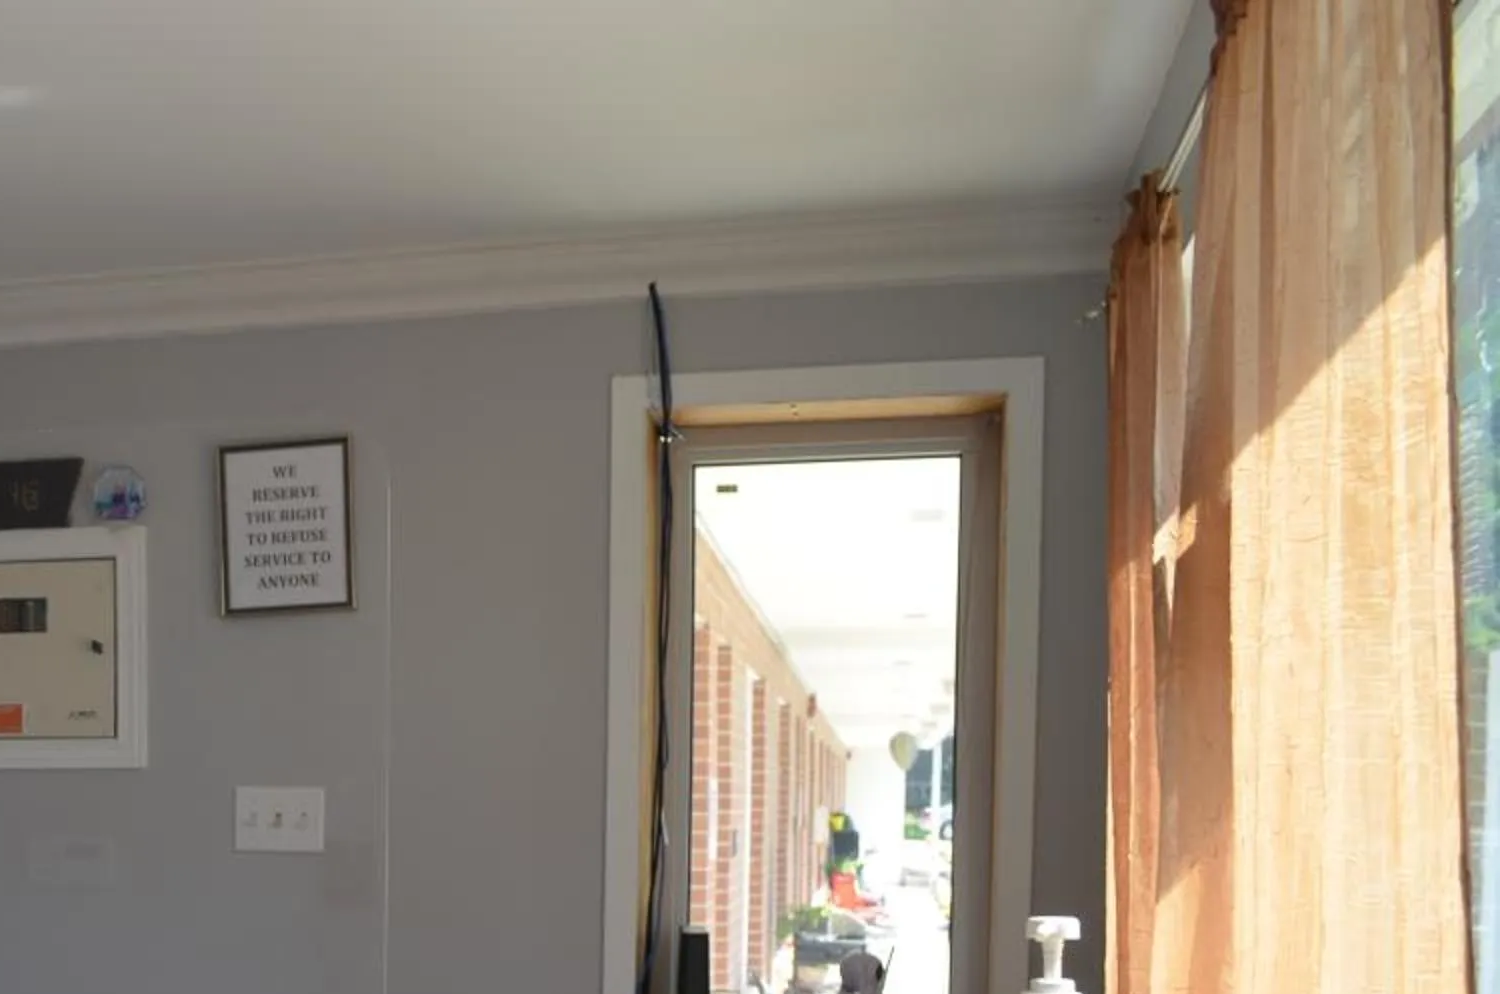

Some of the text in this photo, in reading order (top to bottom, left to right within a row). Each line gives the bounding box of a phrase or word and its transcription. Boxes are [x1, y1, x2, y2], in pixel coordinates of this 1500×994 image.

[273, 465, 296, 479] WE
[252, 485, 319, 502] RESERVE
[245, 507, 328, 525] THE RIGHT
[247, 529, 328, 547] TO REFUSE
[244, 551, 331, 568] SERVICE TO
[258, 573, 319, 589] ANYONE
